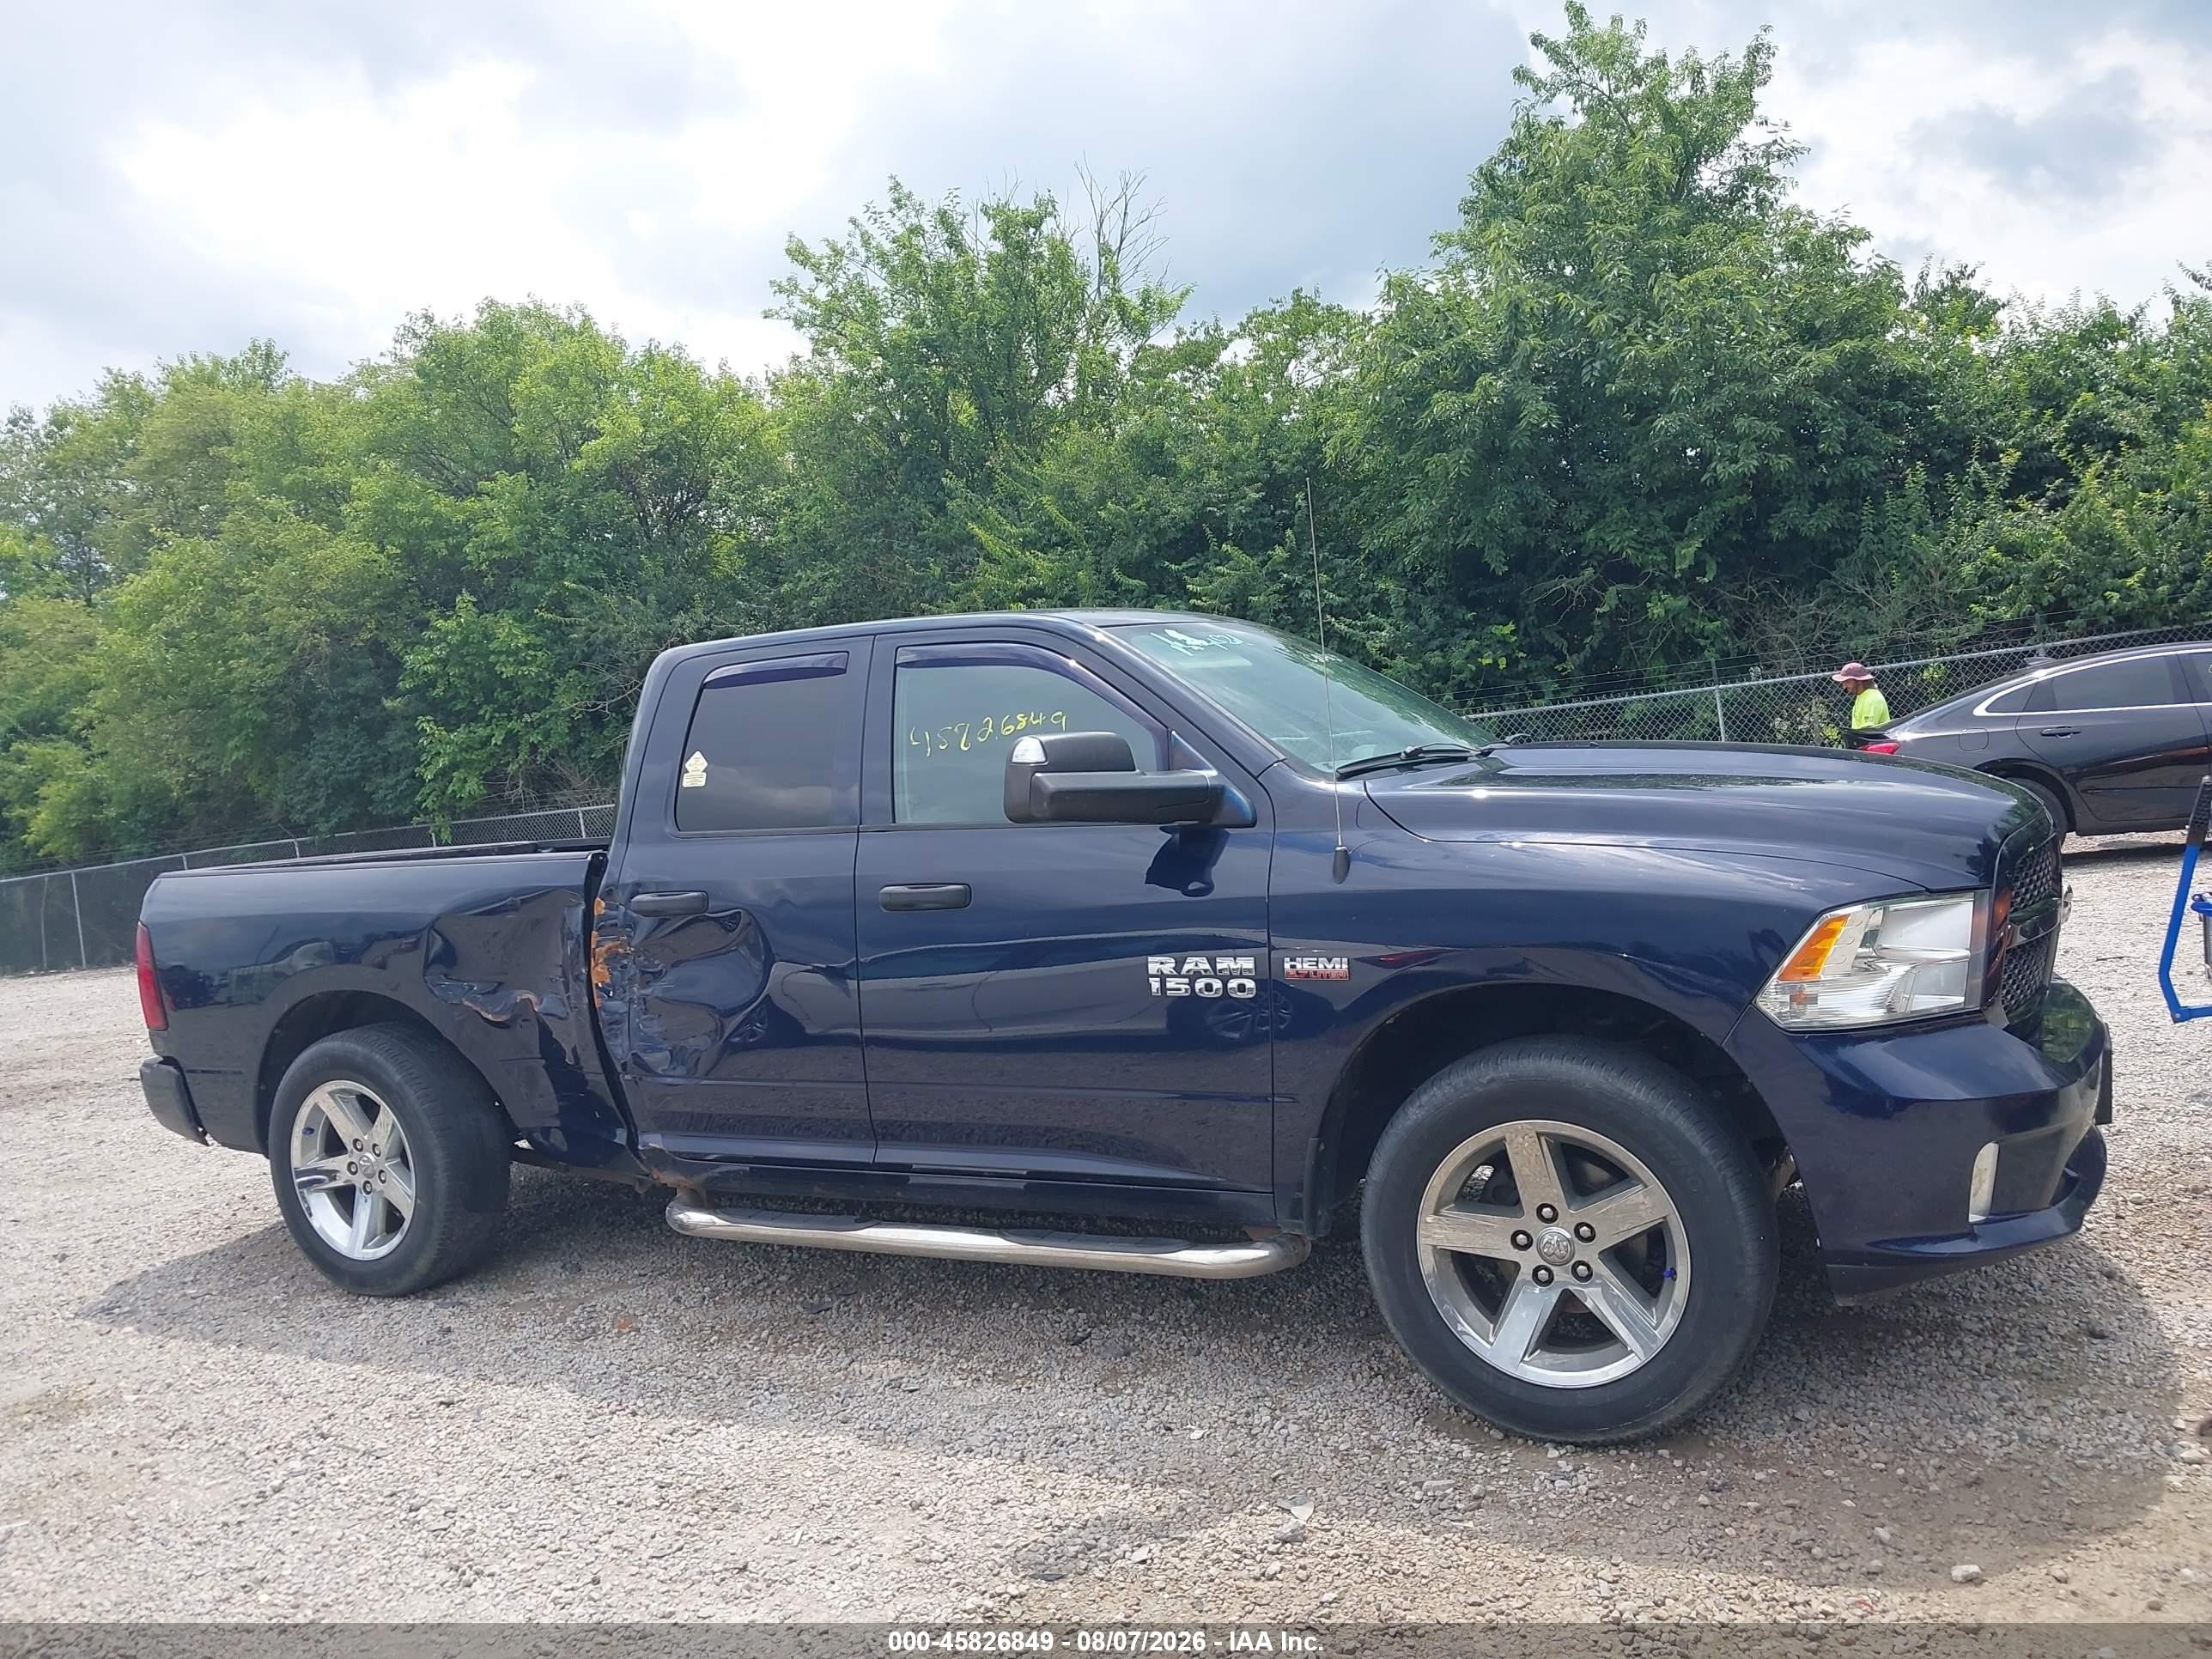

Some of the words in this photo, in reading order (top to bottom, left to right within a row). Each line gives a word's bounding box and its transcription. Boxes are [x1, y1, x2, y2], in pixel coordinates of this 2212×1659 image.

[1147, 957, 1255, 976] RAM
[1284, 957, 1348, 969] HEMI
[1147, 978, 1257, 999] 1500
